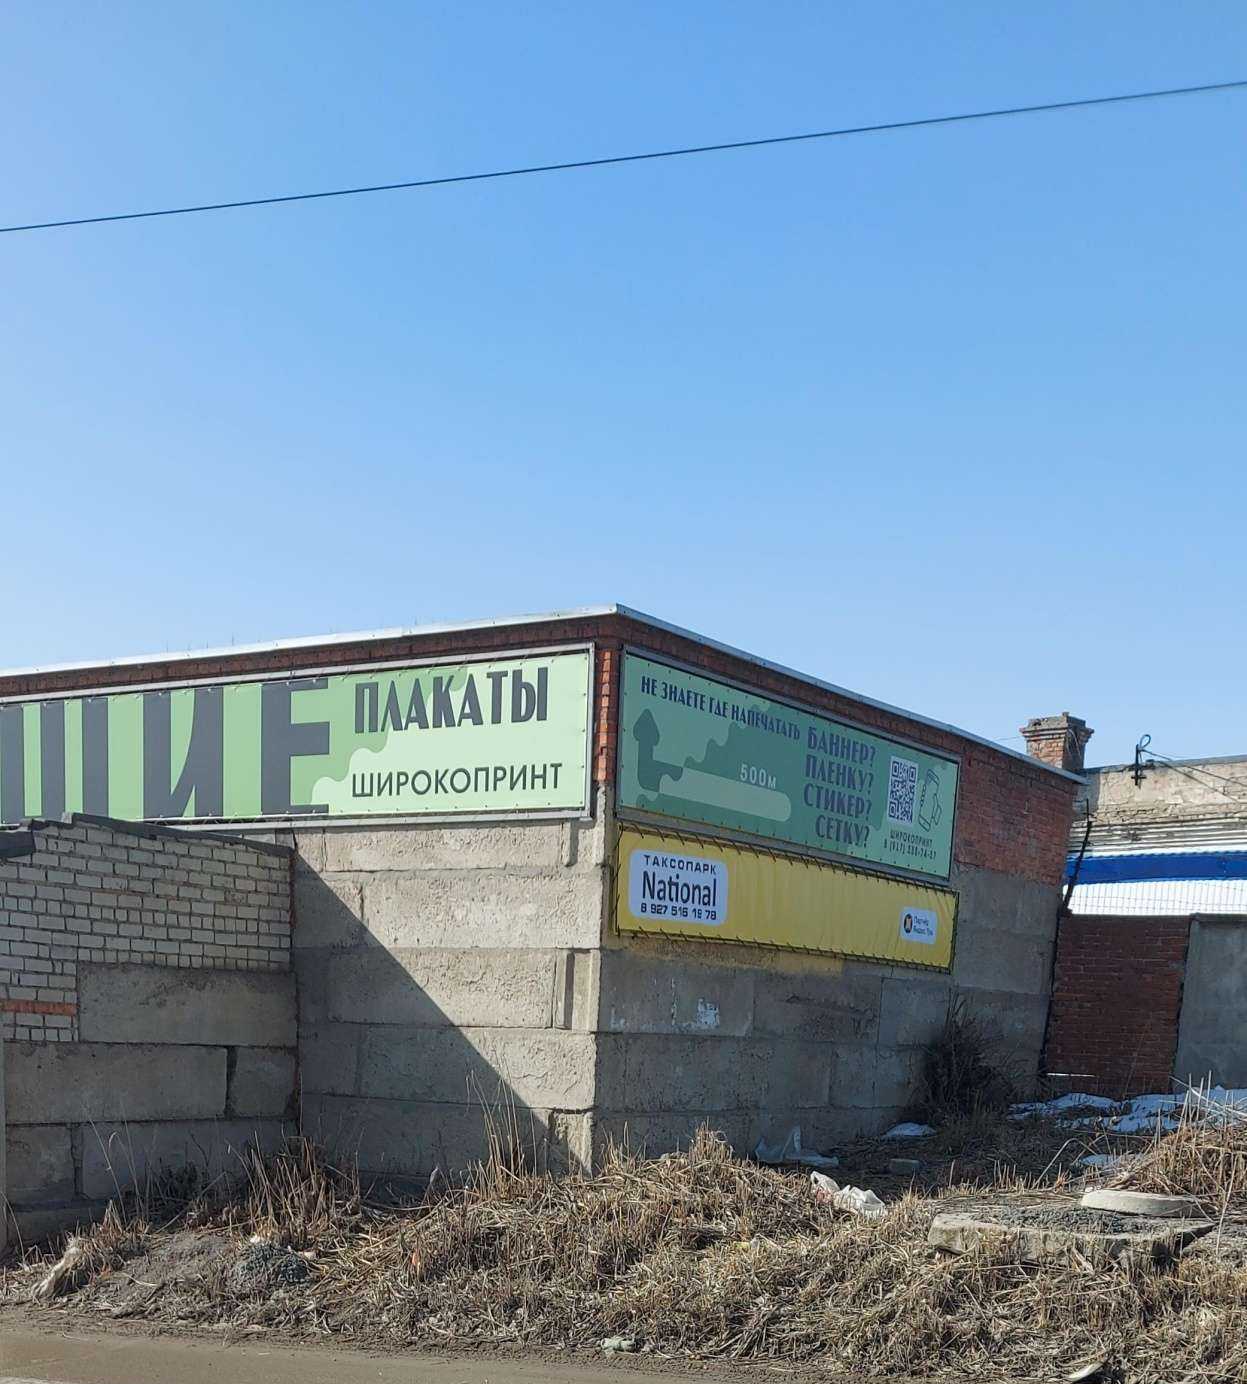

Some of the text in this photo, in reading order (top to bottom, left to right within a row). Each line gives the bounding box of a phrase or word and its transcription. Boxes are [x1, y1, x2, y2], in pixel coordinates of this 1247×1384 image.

[354, 667, 549, 734] ПЛАКАТЫ
[641, 676, 800, 741] НЕ ЗНАЕТЕ ГДЕ НАПЕЧАТАТЬ
[808, 726, 876, 768] БАННЕР?
[352, 762, 562, 798] ШИРОКОПРИНТ
[805, 754, 874, 795] ПЛЕНКУ?
[804, 783, 872, 821] СТИКЕР?
[815, 814, 870, 848] СЕТКУ?
[643, 854, 717, 875] ТАКСОПАРК
[642, 870, 717, 907] National
[641, 902, 647, 913] 8
[650, 904, 668, 915] 927
